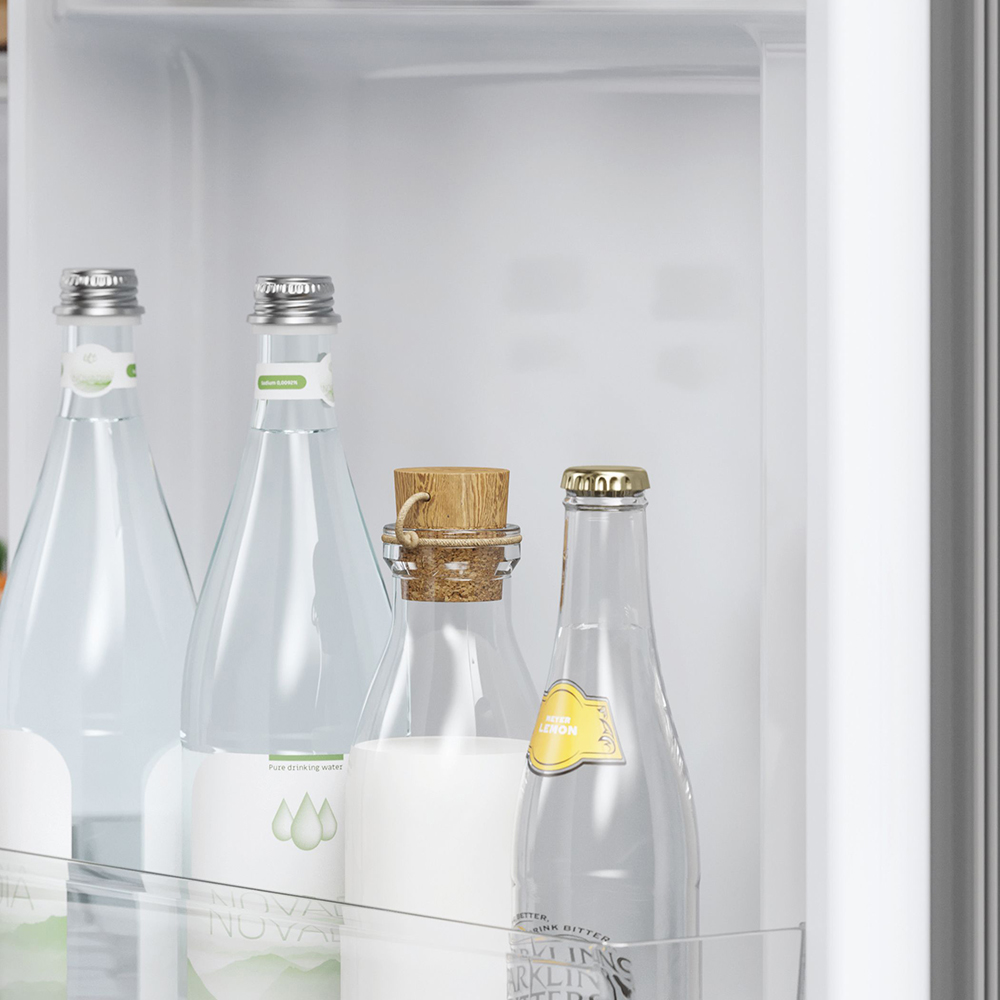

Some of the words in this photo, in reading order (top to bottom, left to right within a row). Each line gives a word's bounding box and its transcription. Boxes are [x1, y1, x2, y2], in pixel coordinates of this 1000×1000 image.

[538, 723, 578, 736] LEMON
[287, 764, 320, 772] drinking
[529, 924, 559, 933] RINK
[563, 924, 611, 942] BITTER
